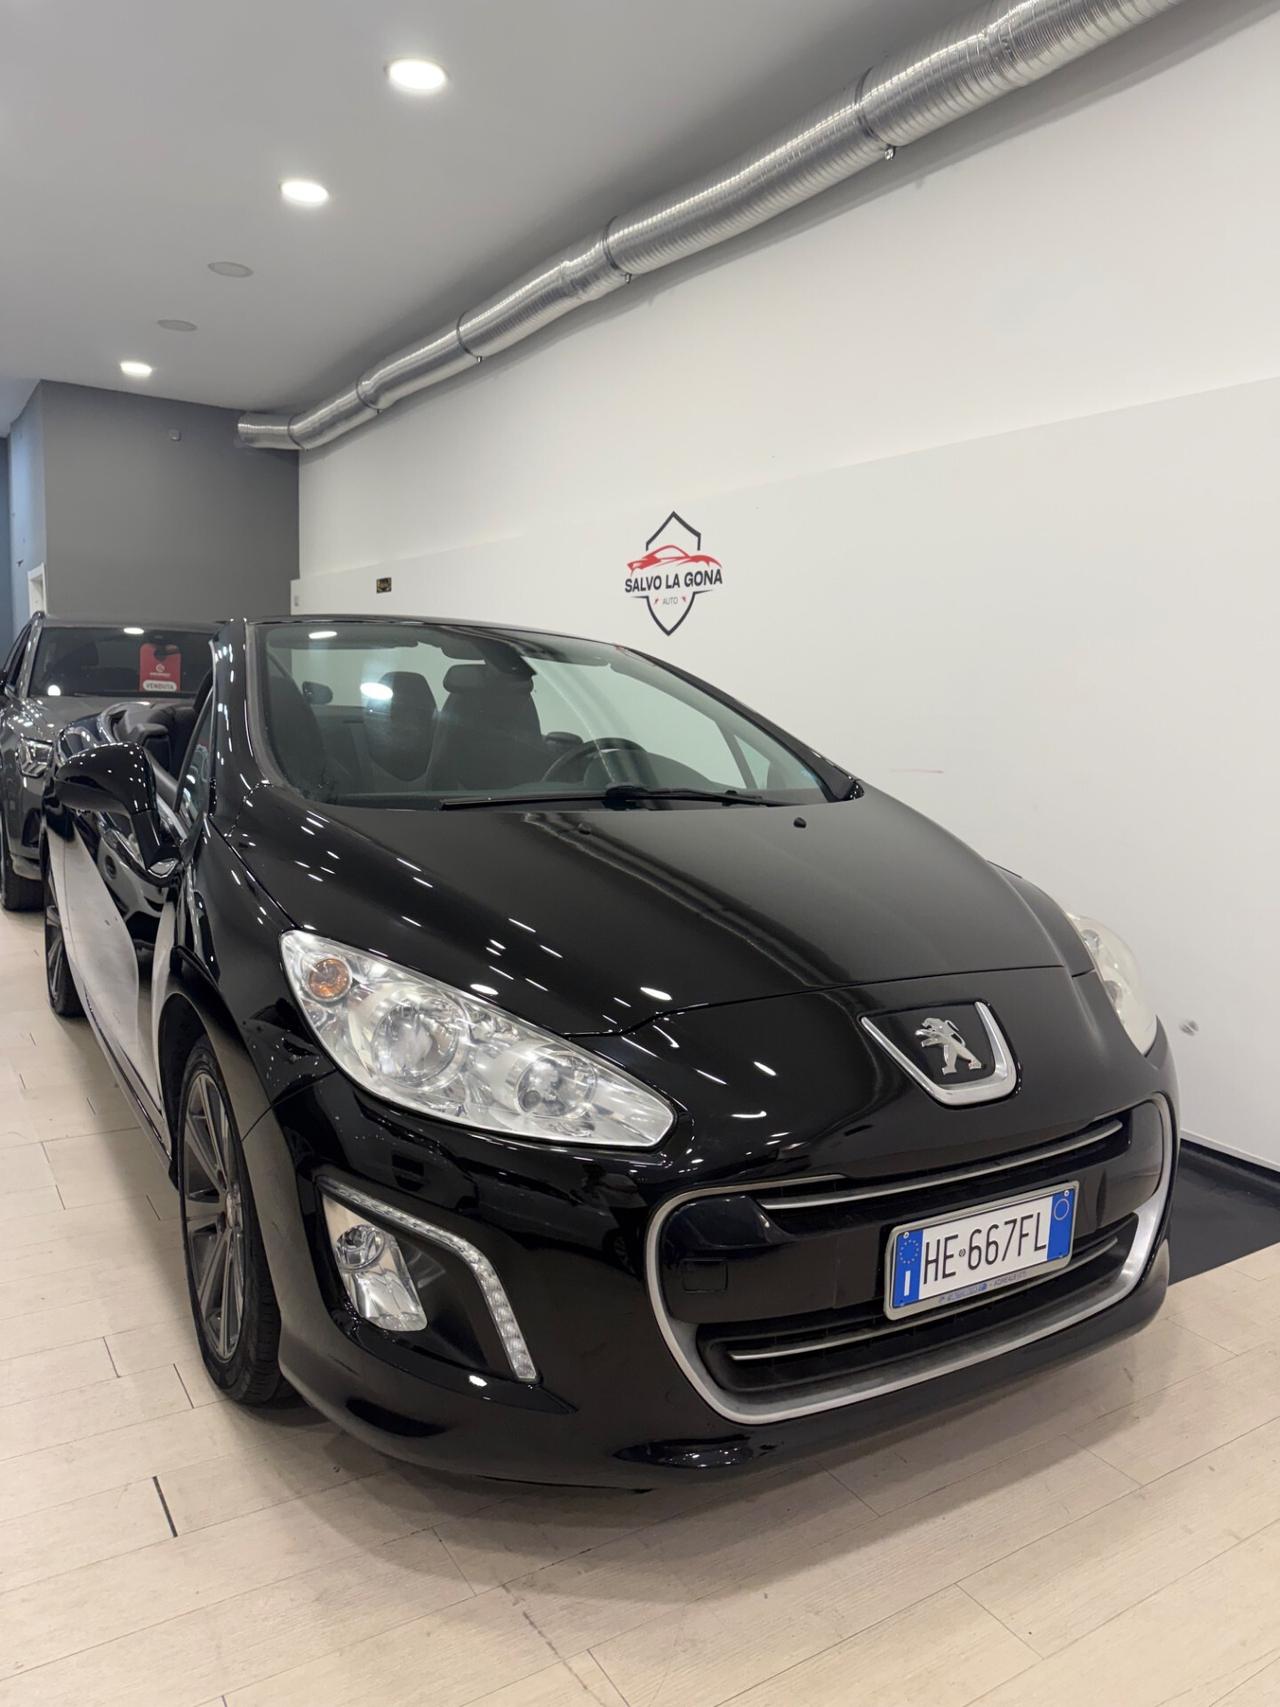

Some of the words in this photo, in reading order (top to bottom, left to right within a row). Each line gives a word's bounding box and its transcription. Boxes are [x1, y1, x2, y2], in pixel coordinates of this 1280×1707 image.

[625, 575, 662, 593] SALVO
[666, 573, 680, 589] LA
[684, 569, 723, 587] GONA
[662, 597, 679, 605] AUTO
